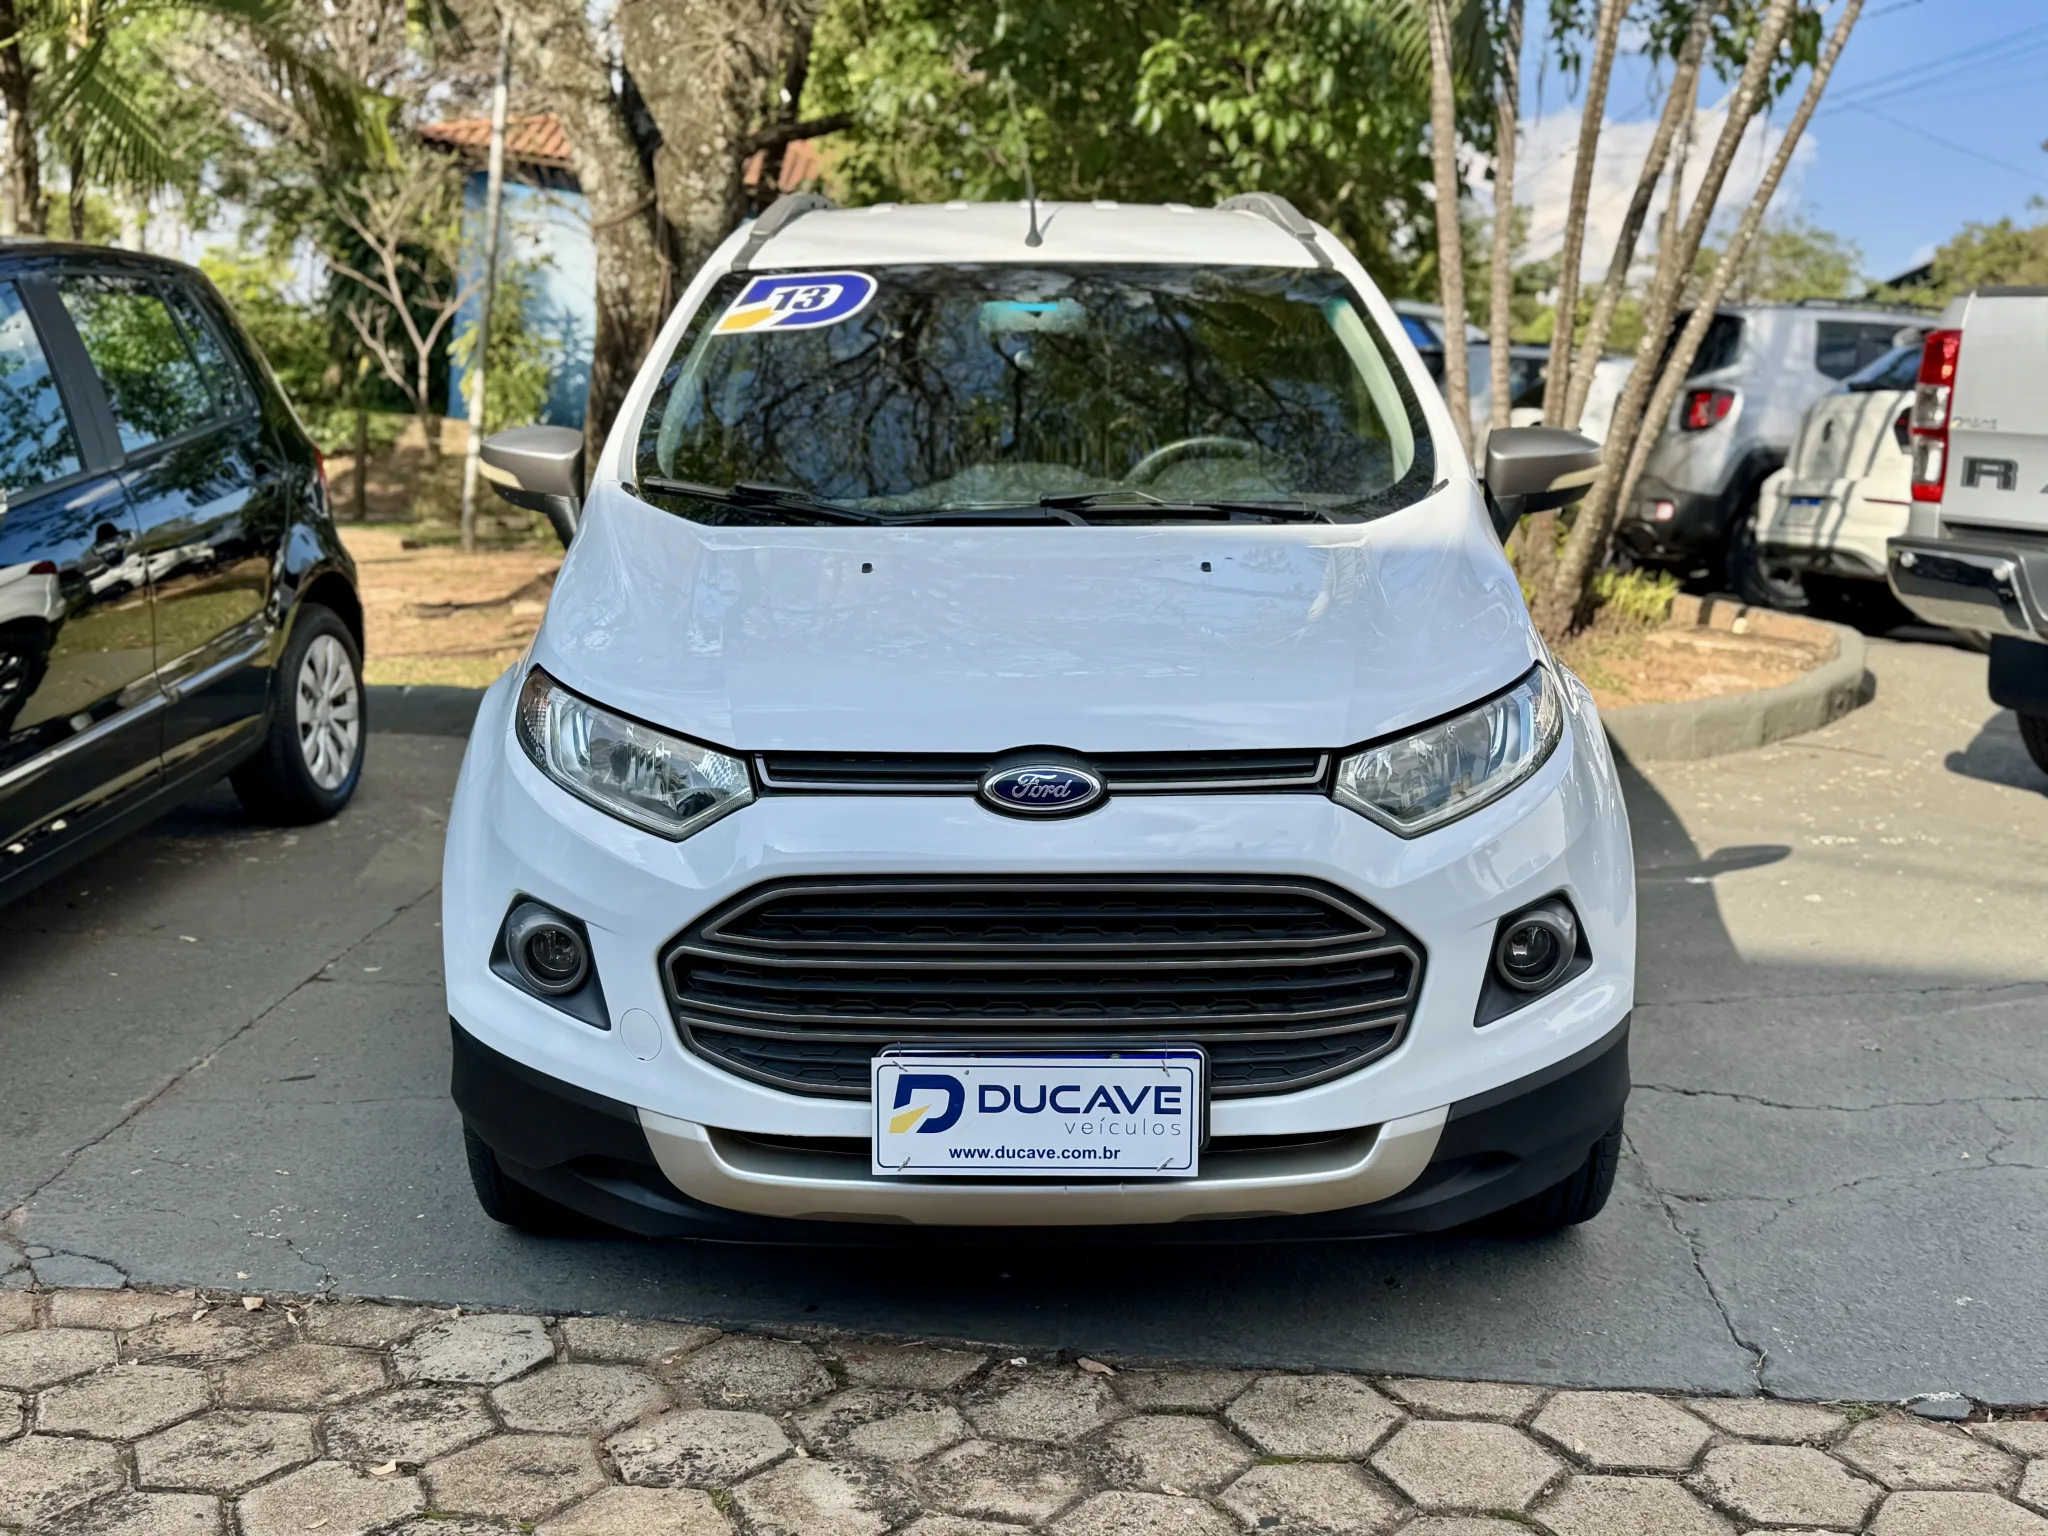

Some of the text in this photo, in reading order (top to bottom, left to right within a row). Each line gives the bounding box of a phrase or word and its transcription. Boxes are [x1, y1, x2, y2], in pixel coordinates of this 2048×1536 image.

[773, 286, 831, 311] 13
[1011, 773, 1073, 799] Ford
[977, 1084, 1182, 1115] DUCAVE
[1064, 1117, 1182, 1136] veículos
[948, 1145, 1121, 1160] www.ducave.com.br
